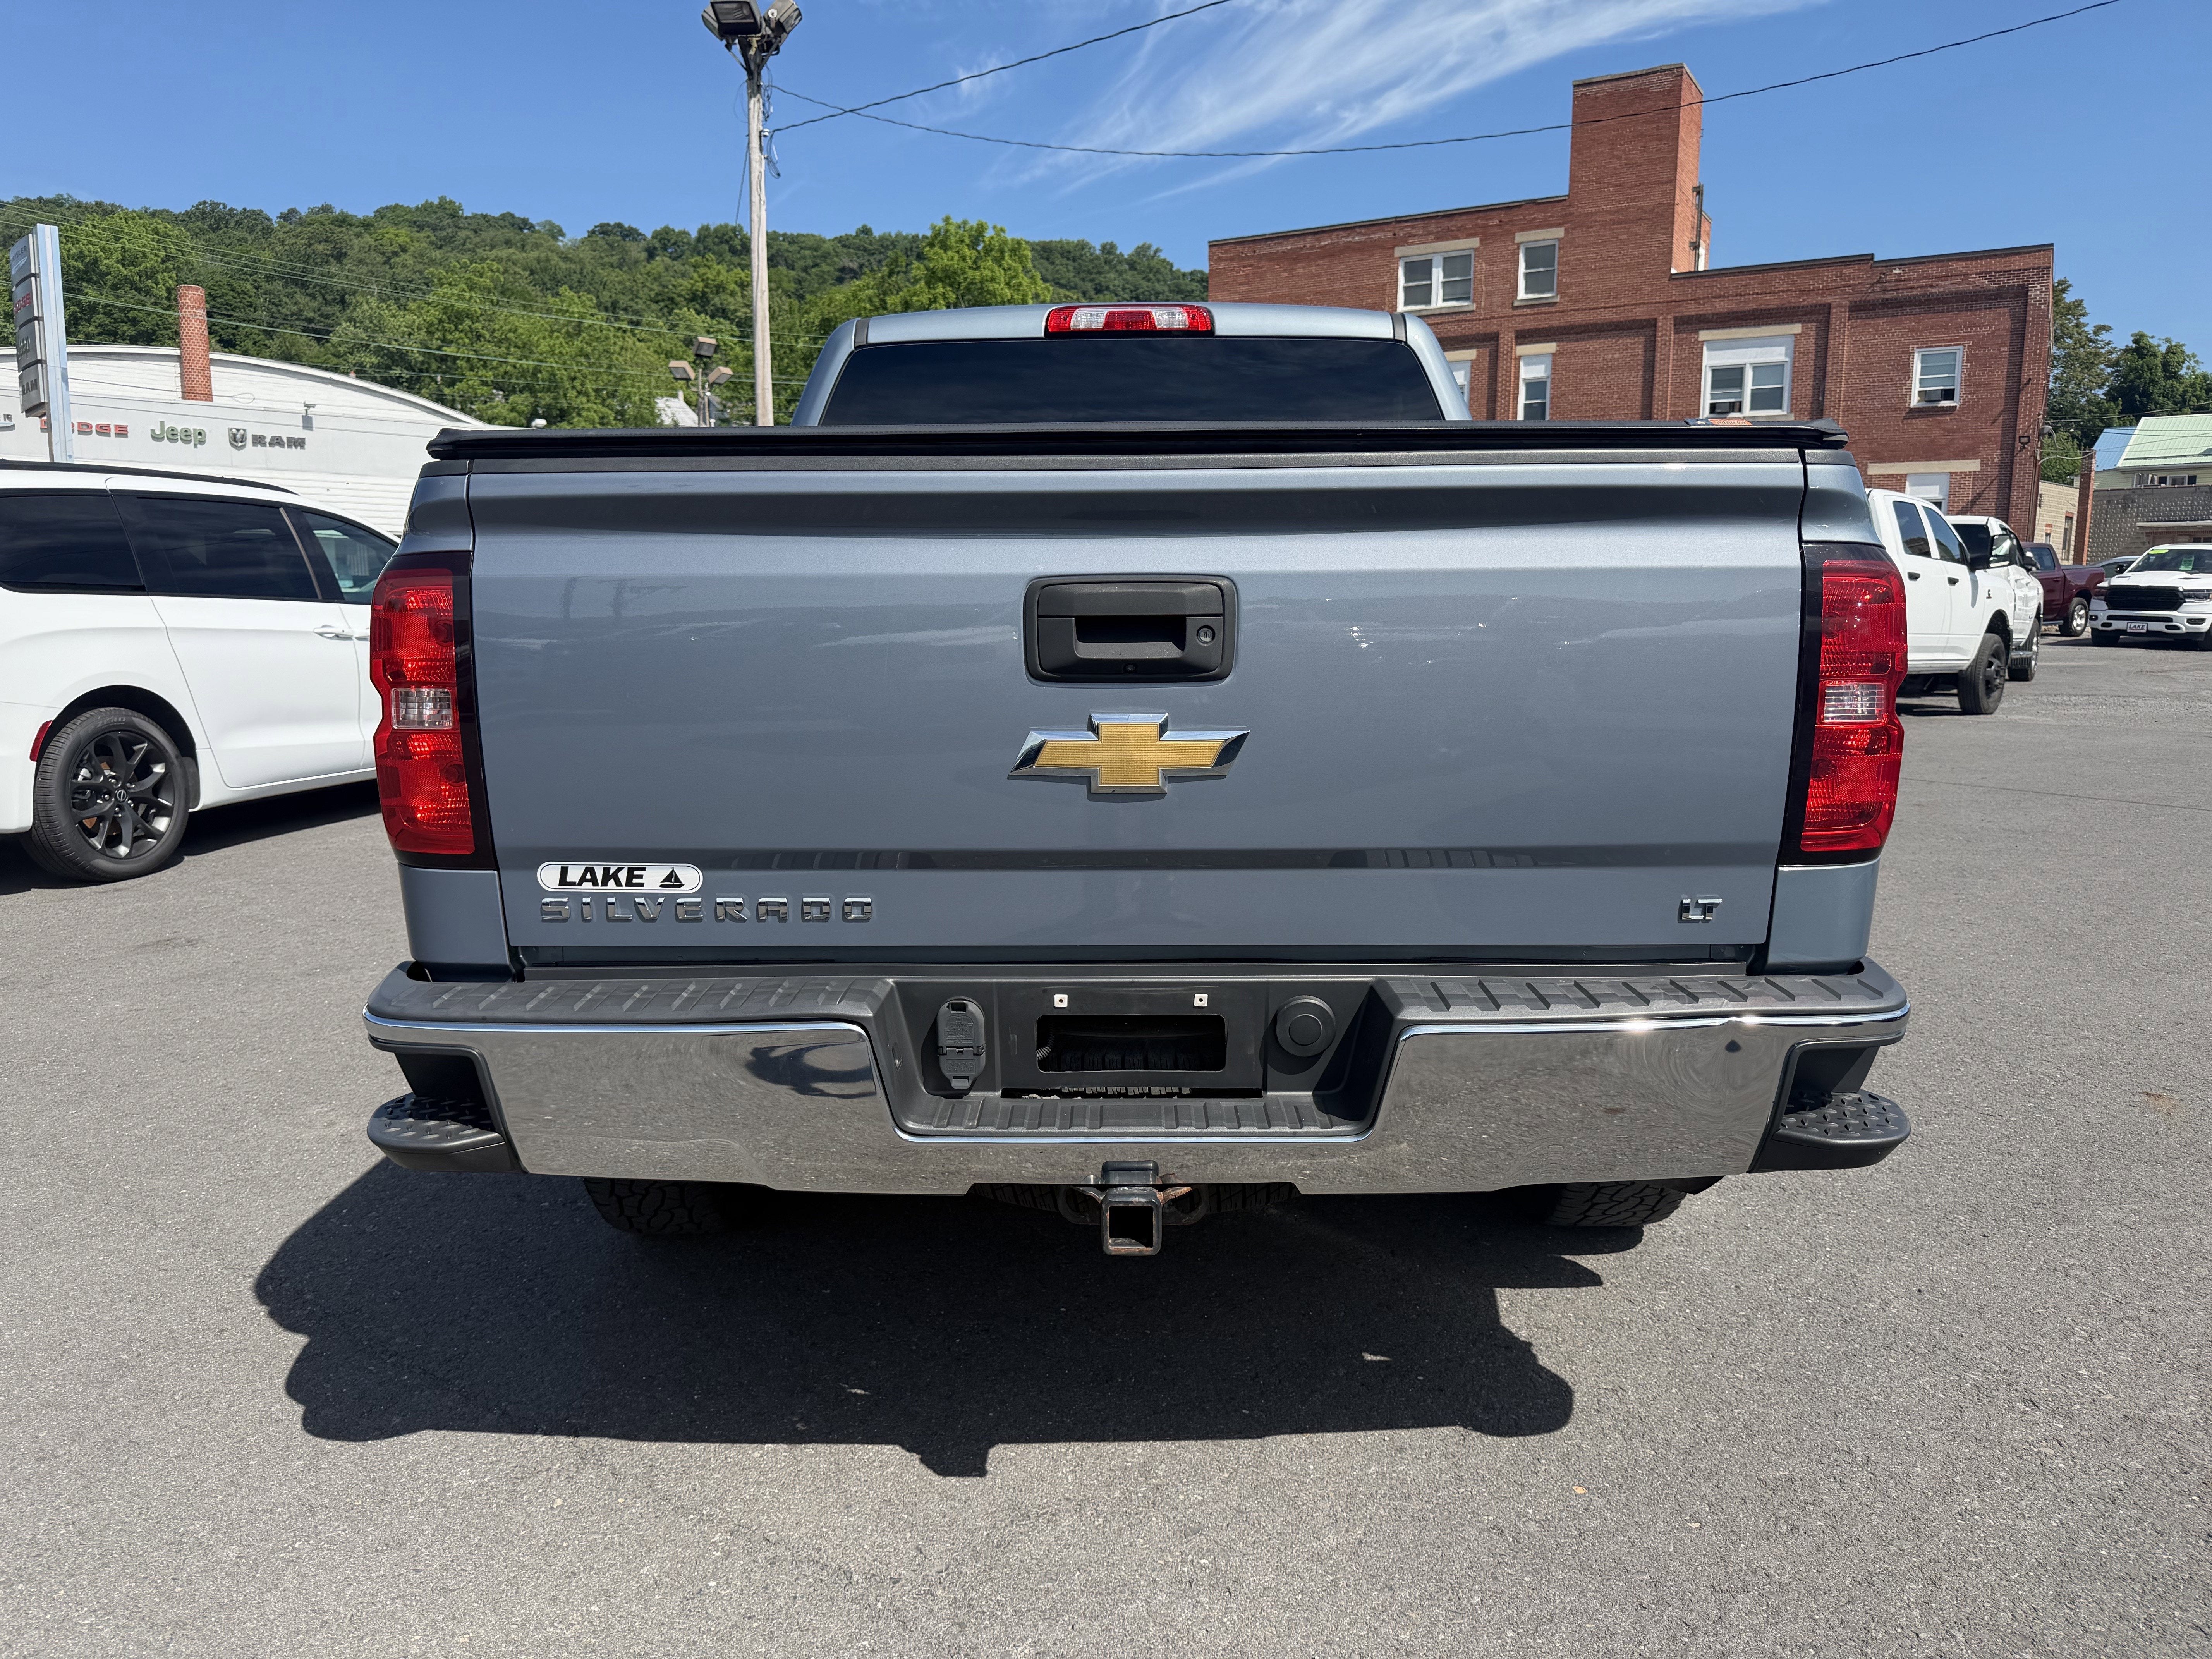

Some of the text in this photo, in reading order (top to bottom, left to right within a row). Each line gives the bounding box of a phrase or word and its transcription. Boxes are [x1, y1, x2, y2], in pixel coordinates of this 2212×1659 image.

[150, 421, 207, 445] Jeep
[251, 434, 306, 447] RAM
[558, 866, 646, 887] LAKE
[541, 896, 873, 921] SILVERADO
[1682, 898, 1723, 920] LT
